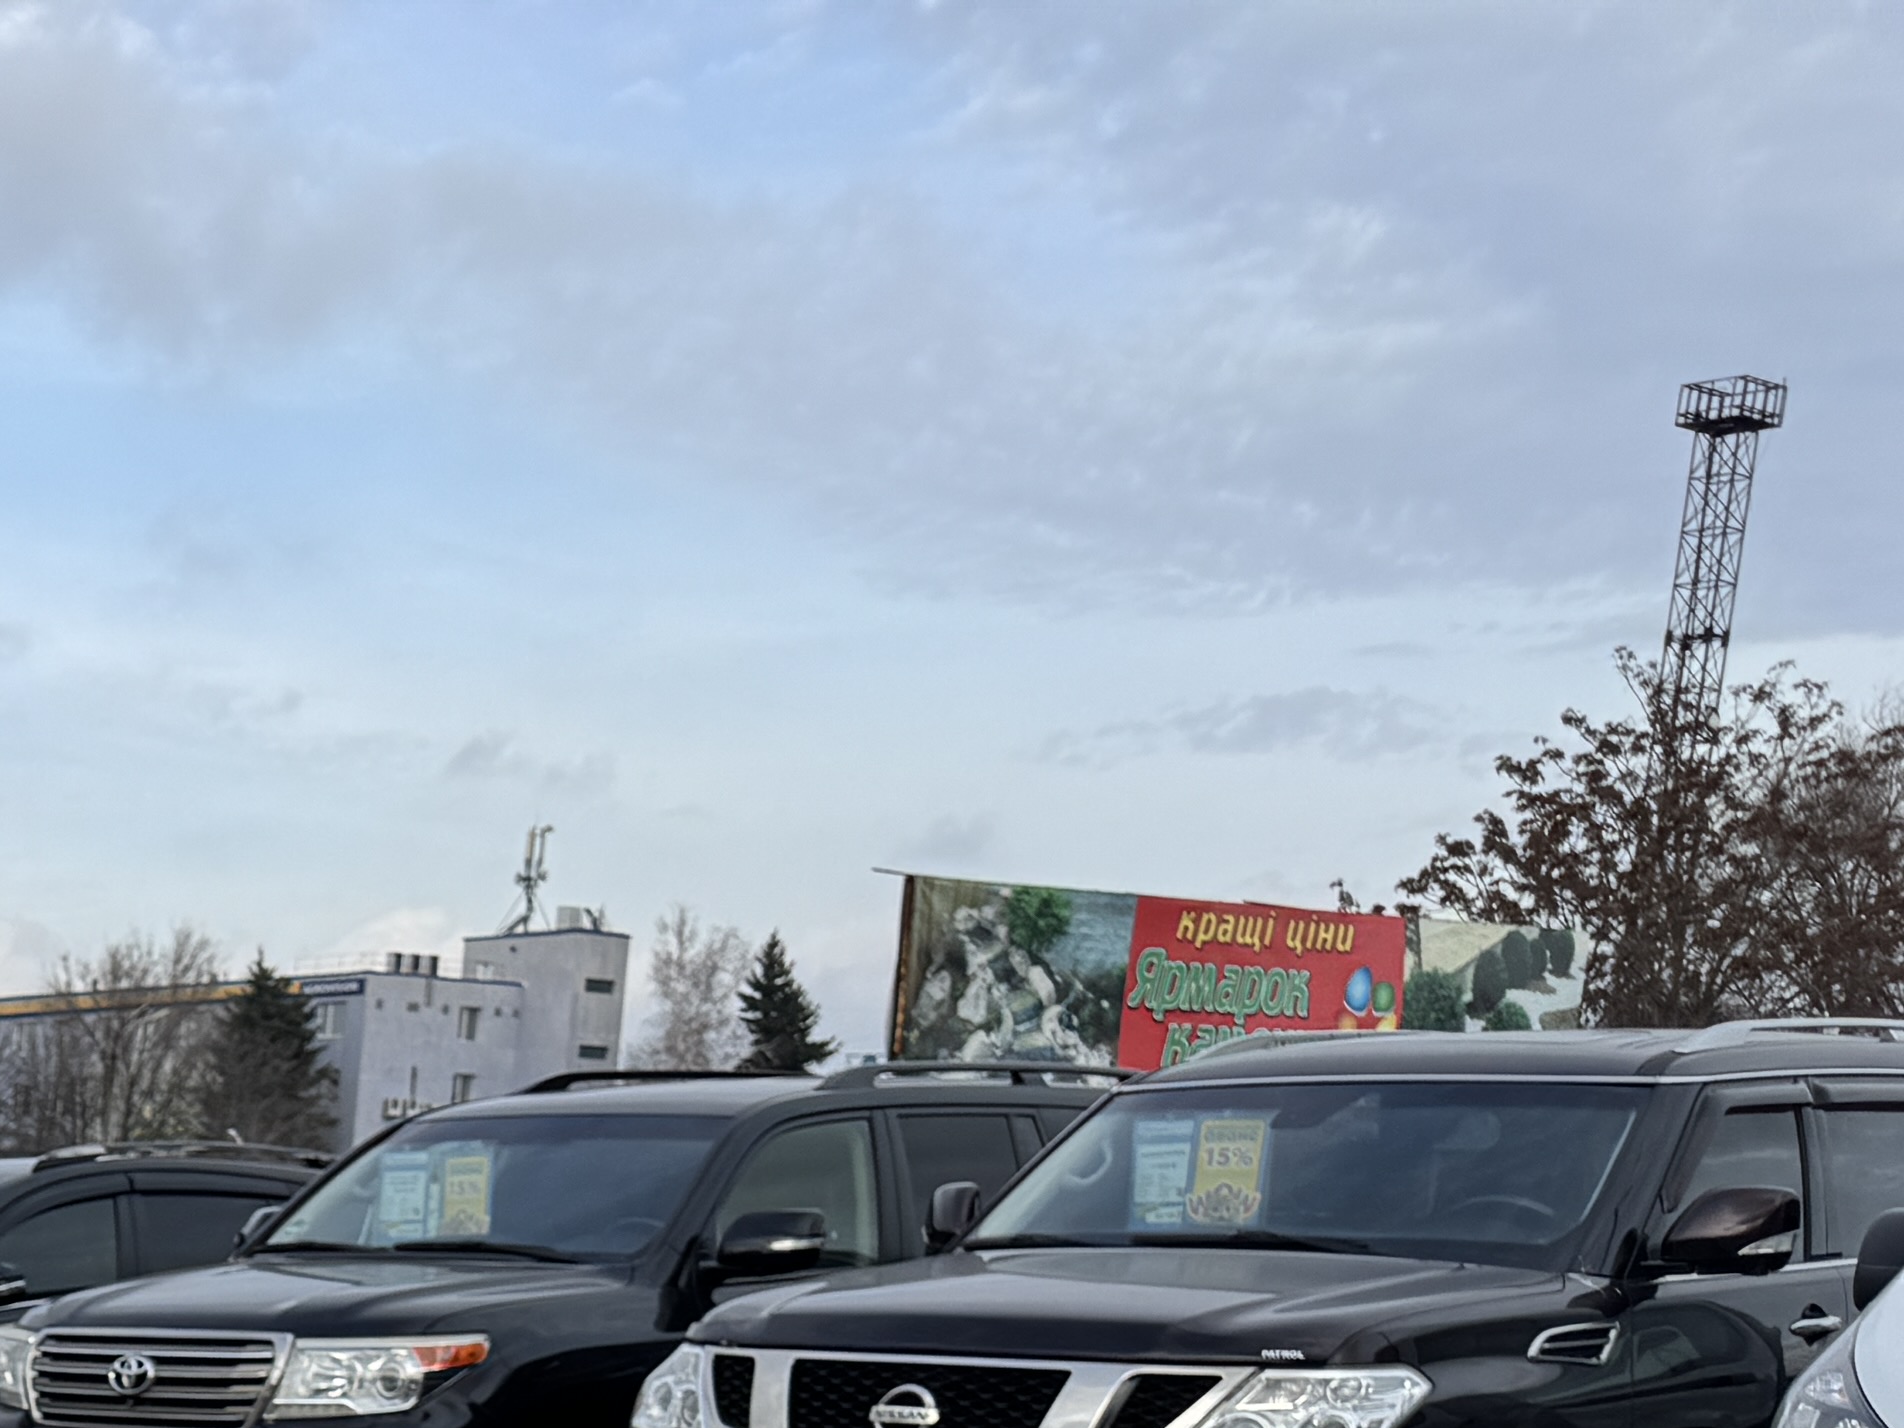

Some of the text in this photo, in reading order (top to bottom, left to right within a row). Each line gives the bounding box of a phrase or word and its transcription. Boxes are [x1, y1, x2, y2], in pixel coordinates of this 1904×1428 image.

[1176, 910, 1356, 957] кращі ціни
[1127, 947, 1311, 1024] Ярмарок
[1206, 1147, 1254, 1168] 15%
